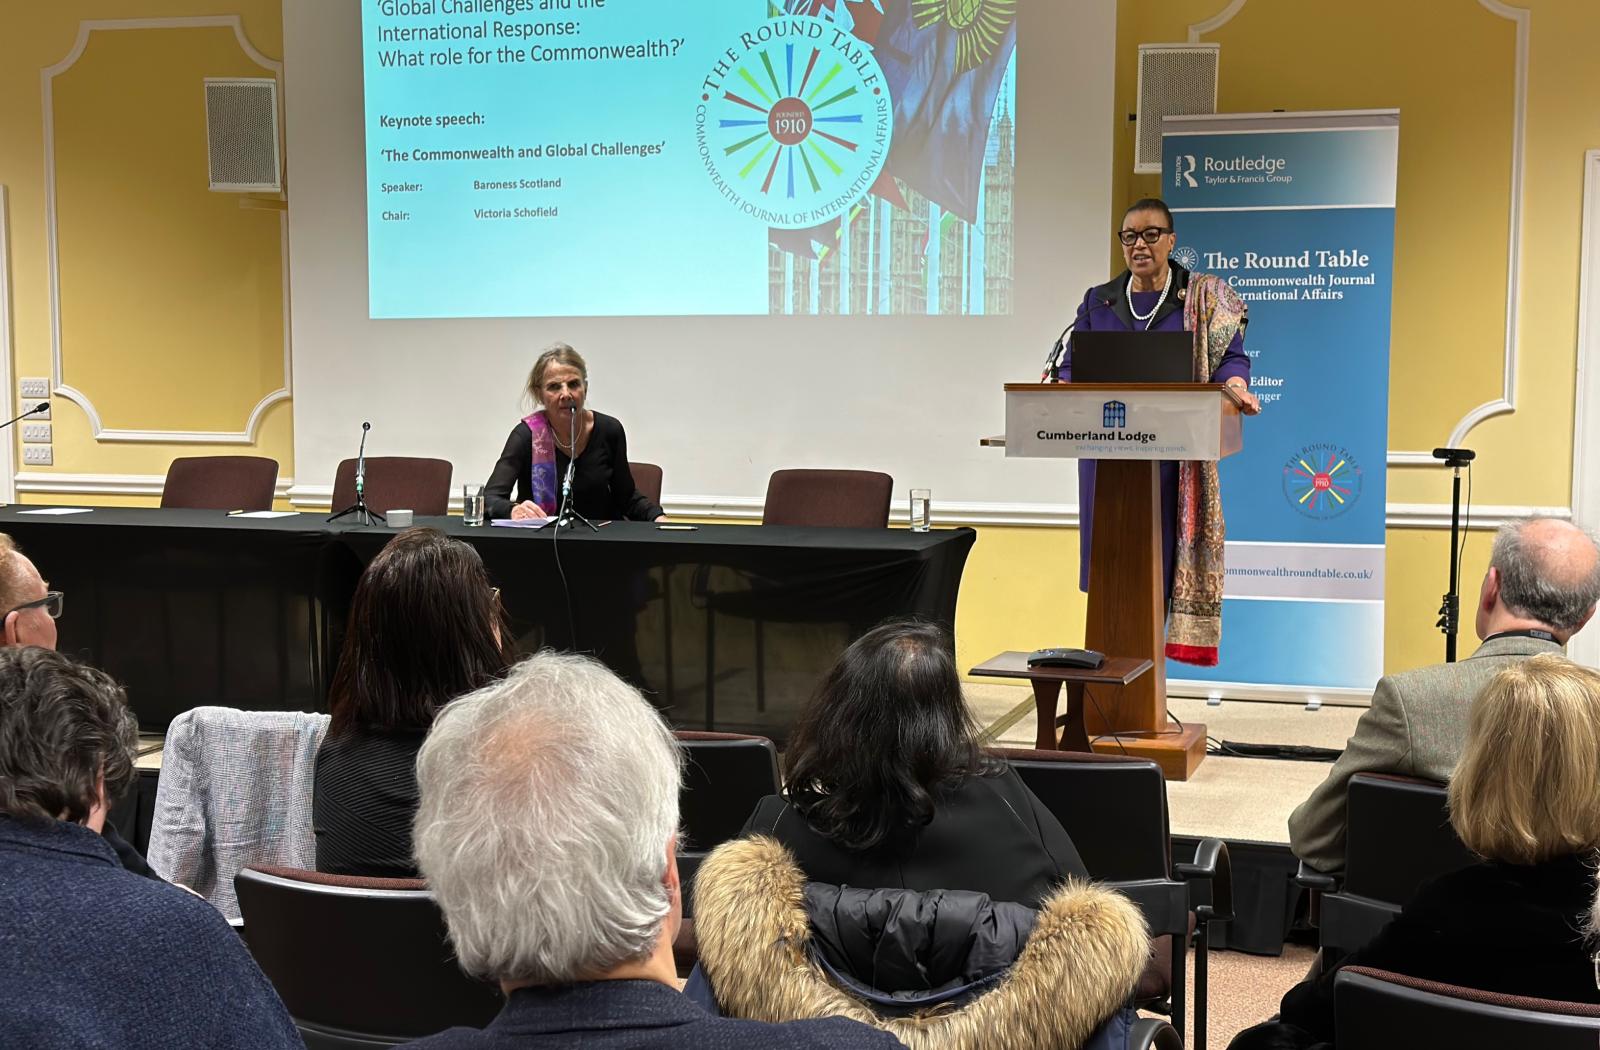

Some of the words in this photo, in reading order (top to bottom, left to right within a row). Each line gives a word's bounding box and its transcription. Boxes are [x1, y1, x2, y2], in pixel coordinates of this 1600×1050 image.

[442, 0, 534, 15] Challenges
[378, 20, 487, 42] International
[493, 20, 580, 40] Response:
[378, 49, 424, 67] What
[430, 47, 462, 66] role
[467, 46, 492, 65] for
[497, 46, 526, 64] the
[531, 38, 685, 62] Commonwealth?’
[703, 48, 739, 91] THE
[740, 21, 823, 50] ROUND
[831, 28, 878, 88] TABLE
[380, 115, 432, 129] Keynote
[436, 112, 485, 128] speech:
[776, 119, 806, 135] 1910
[381, 149, 409, 162] ‘The
[412, 145, 514, 160] Commonwealth
[518, 145, 542, 157] and
[546, 143, 587, 157] Global
[591, 141, 665, 157] Challenges’
[696, 104, 740, 205] COMMONWEALTH
[739, 197, 791, 224] JOURNAL
[793, 213, 809, 224] OF
[811, 149, 883, 221] INTERNATIONAL
[875, 97, 887, 148] AFFAIRS
[1204, 155, 1286, 174] Routledge
[473, 179, 517, 190] Baroness
[519, 177, 561, 189] Scotland
[1205, 175, 1227, 186] Taylor
[1229, 175, 1236, 184] &
[1238, 175, 1265, 184] Francis
[1266, 174, 1293, 185] Group
[381, 182, 423, 194] Speaker:
[382, 211, 410, 221] Chair:
[474, 208, 512, 219] Victoria
[514, 206, 558, 218] Schofield
[1204, 251, 1240, 270] The
[1244, 250, 1310, 269] Round
[1315, 249, 1370, 268] Table
[1228, 274, 1325, 287] Commonwealth
[1329, 273, 1375, 287] Journal
[1240, 289, 1298, 300] rnational
[1301, 289, 1343, 300] Affairs
[1250, 376, 1283, 386] Editor
[1254, 391, 1281, 403] inger
[1036, 430, 1115, 441] Cumberland
[1118, 431, 1156, 444] Lodge
[1224, 567, 1374, 580] ommonwealthroundtable.co.uk/
